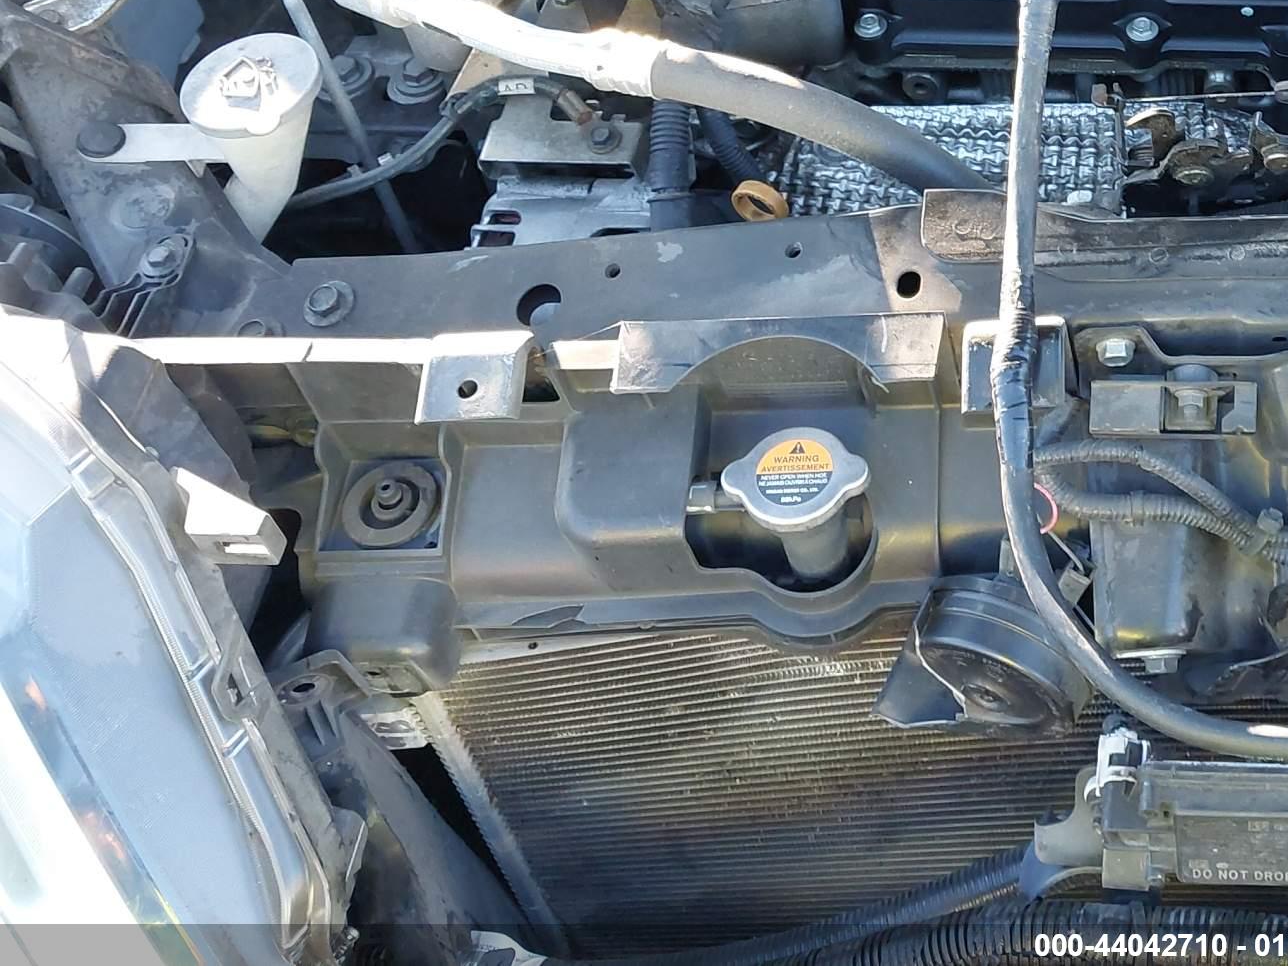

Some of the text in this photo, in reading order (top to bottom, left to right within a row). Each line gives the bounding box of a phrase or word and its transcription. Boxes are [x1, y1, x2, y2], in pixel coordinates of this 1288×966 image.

[774, 455, 819, 463] WARNING
[761, 462, 830, 473] AVERTISSEMENT
[1192, 868, 1213, 880] DO
[1218, 869, 1249, 881] NOT
